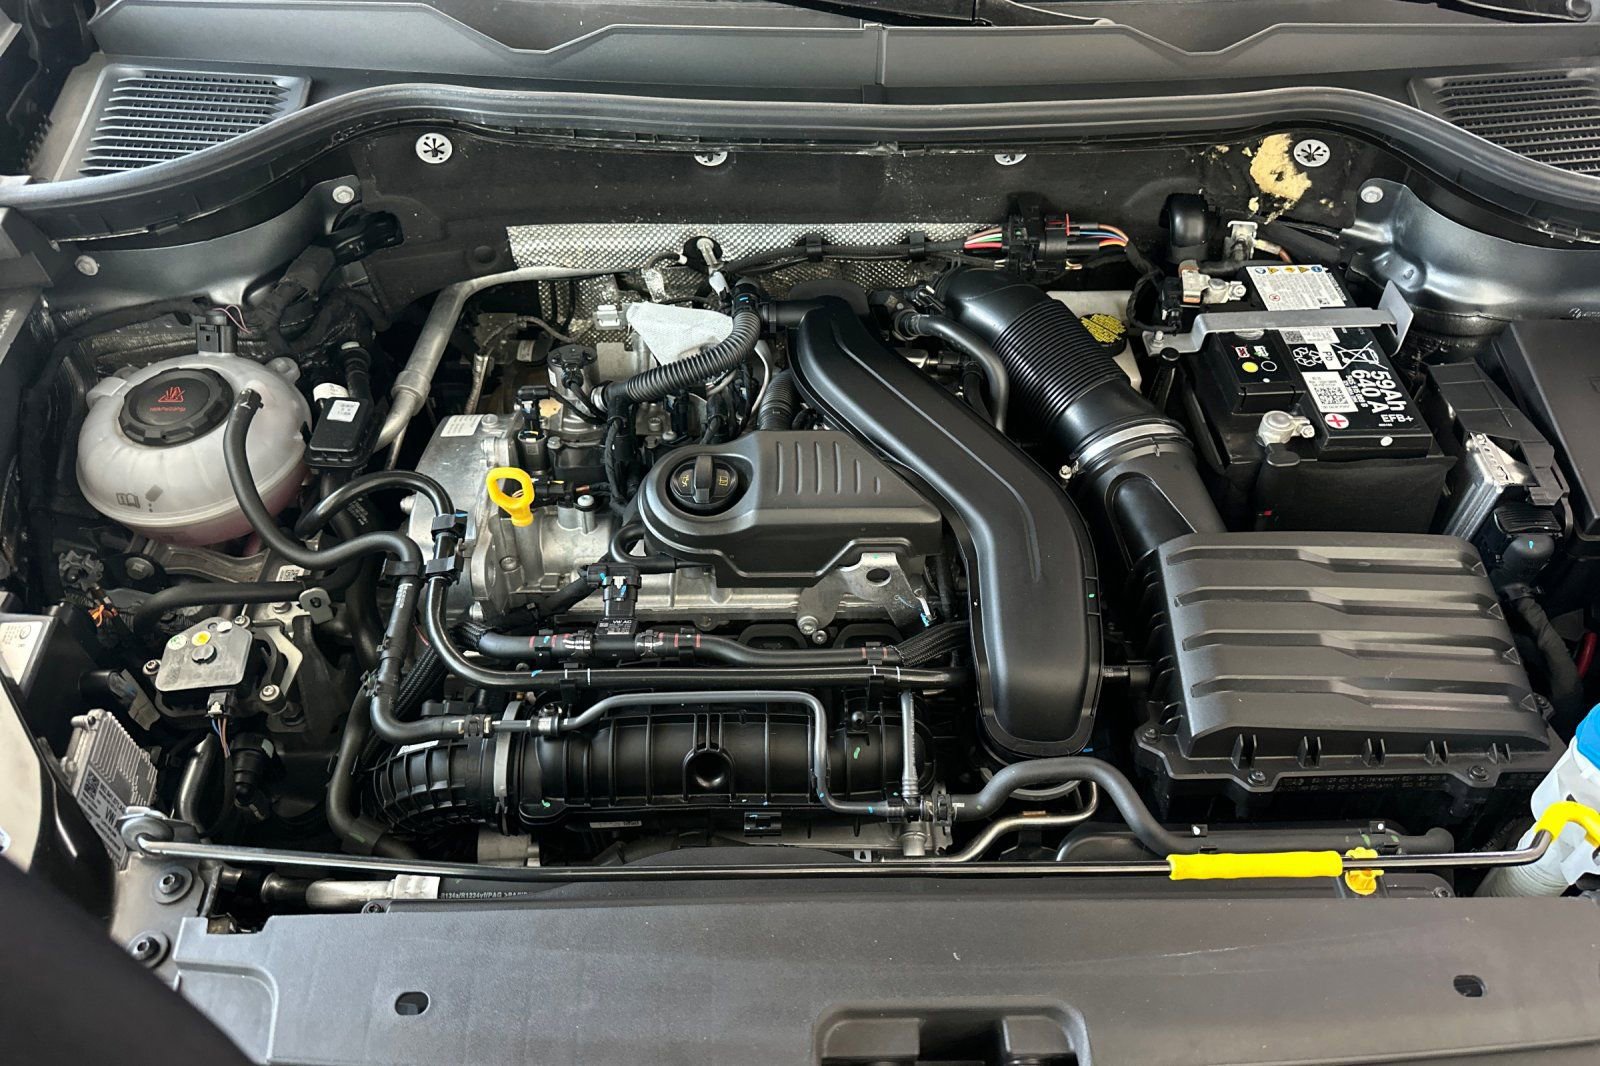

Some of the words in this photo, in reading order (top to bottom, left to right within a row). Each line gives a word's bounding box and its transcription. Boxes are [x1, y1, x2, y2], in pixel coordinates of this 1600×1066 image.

[1322, 351, 1333, 361] Pb
[1351, 369, 1381, 398] 640
[1366, 400, 1390, 414] A
[1370, 370, 1407, 411] 59Ah
[1380, 413, 1414, 423] EFB+
